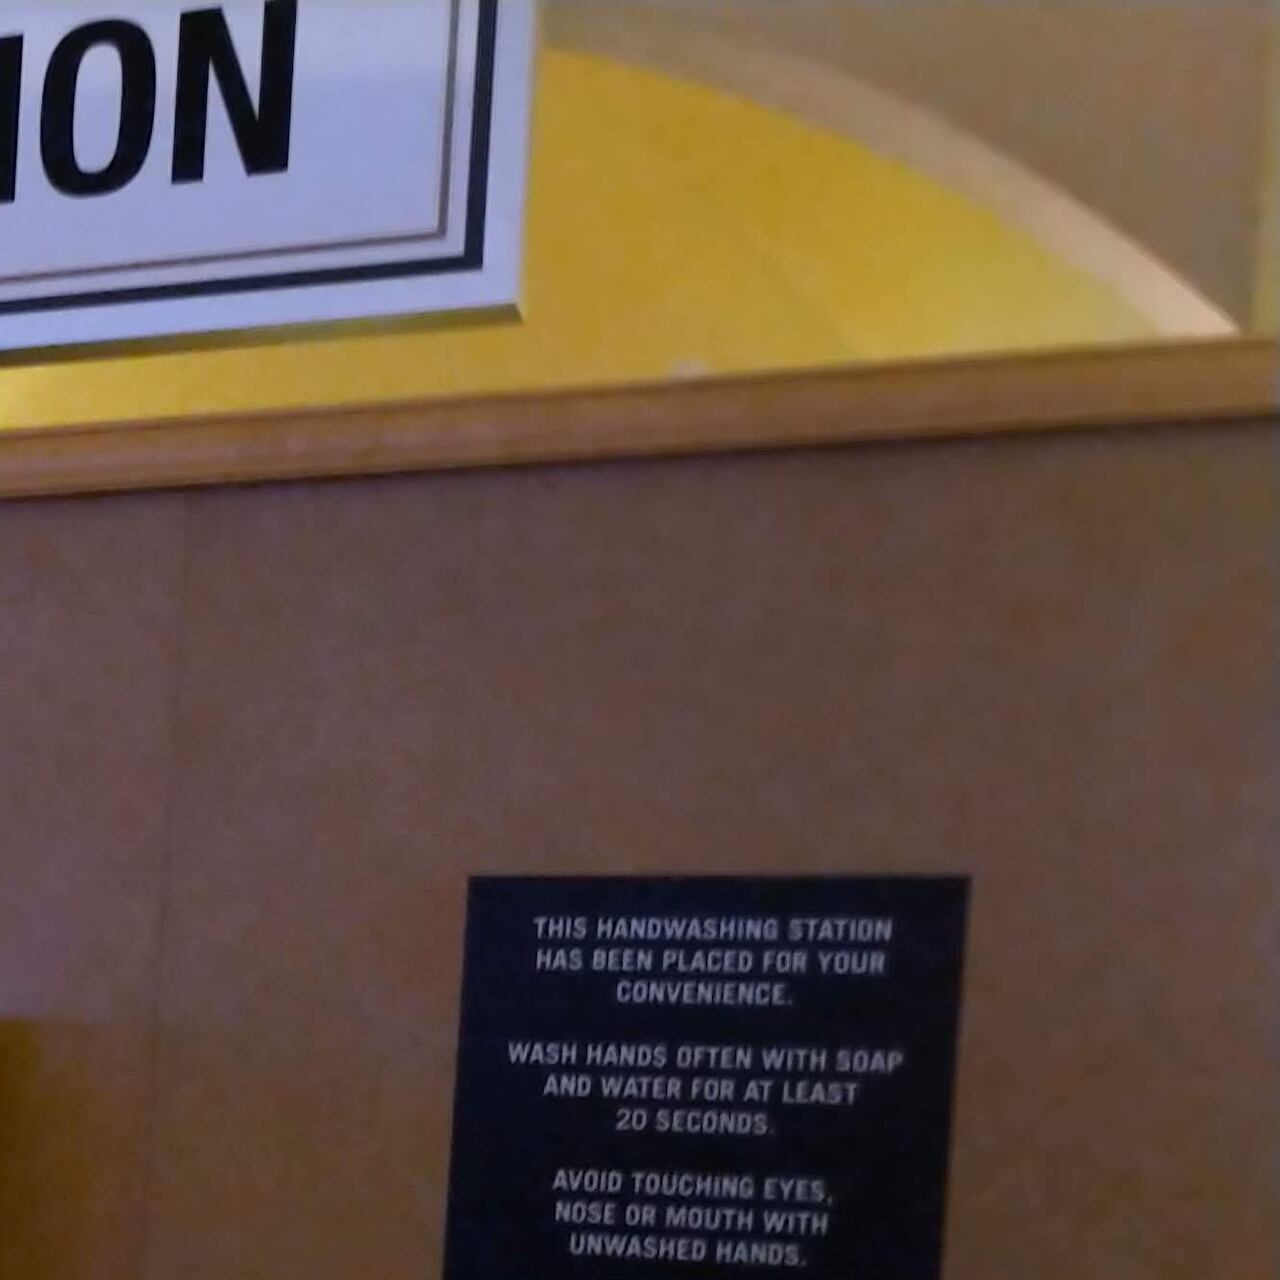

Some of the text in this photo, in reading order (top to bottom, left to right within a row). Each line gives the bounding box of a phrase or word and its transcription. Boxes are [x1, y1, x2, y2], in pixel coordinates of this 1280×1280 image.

[533, 916, 894, 943] THIS HANDWASHING STATION
[536, 947, 886, 976] HAS BEEN PLACED FOR YOUR
[617, 979, 793, 1006] CONVENIENCE.
[508, 1041, 904, 1074] WASH HANDS OFTEN WITH SOAP
[543, 1073, 860, 1105] AND WATER FOR AT LEAST
[616, 1107, 774, 1136] 20 SECONDS.
[552, 1168, 833, 1206] AVOID TOUCHING EYES,
[555, 1200, 829, 1236] NOSE OR MOUTH WITH
[569, 1232, 807, 1267] UNWASHED HANDS.
